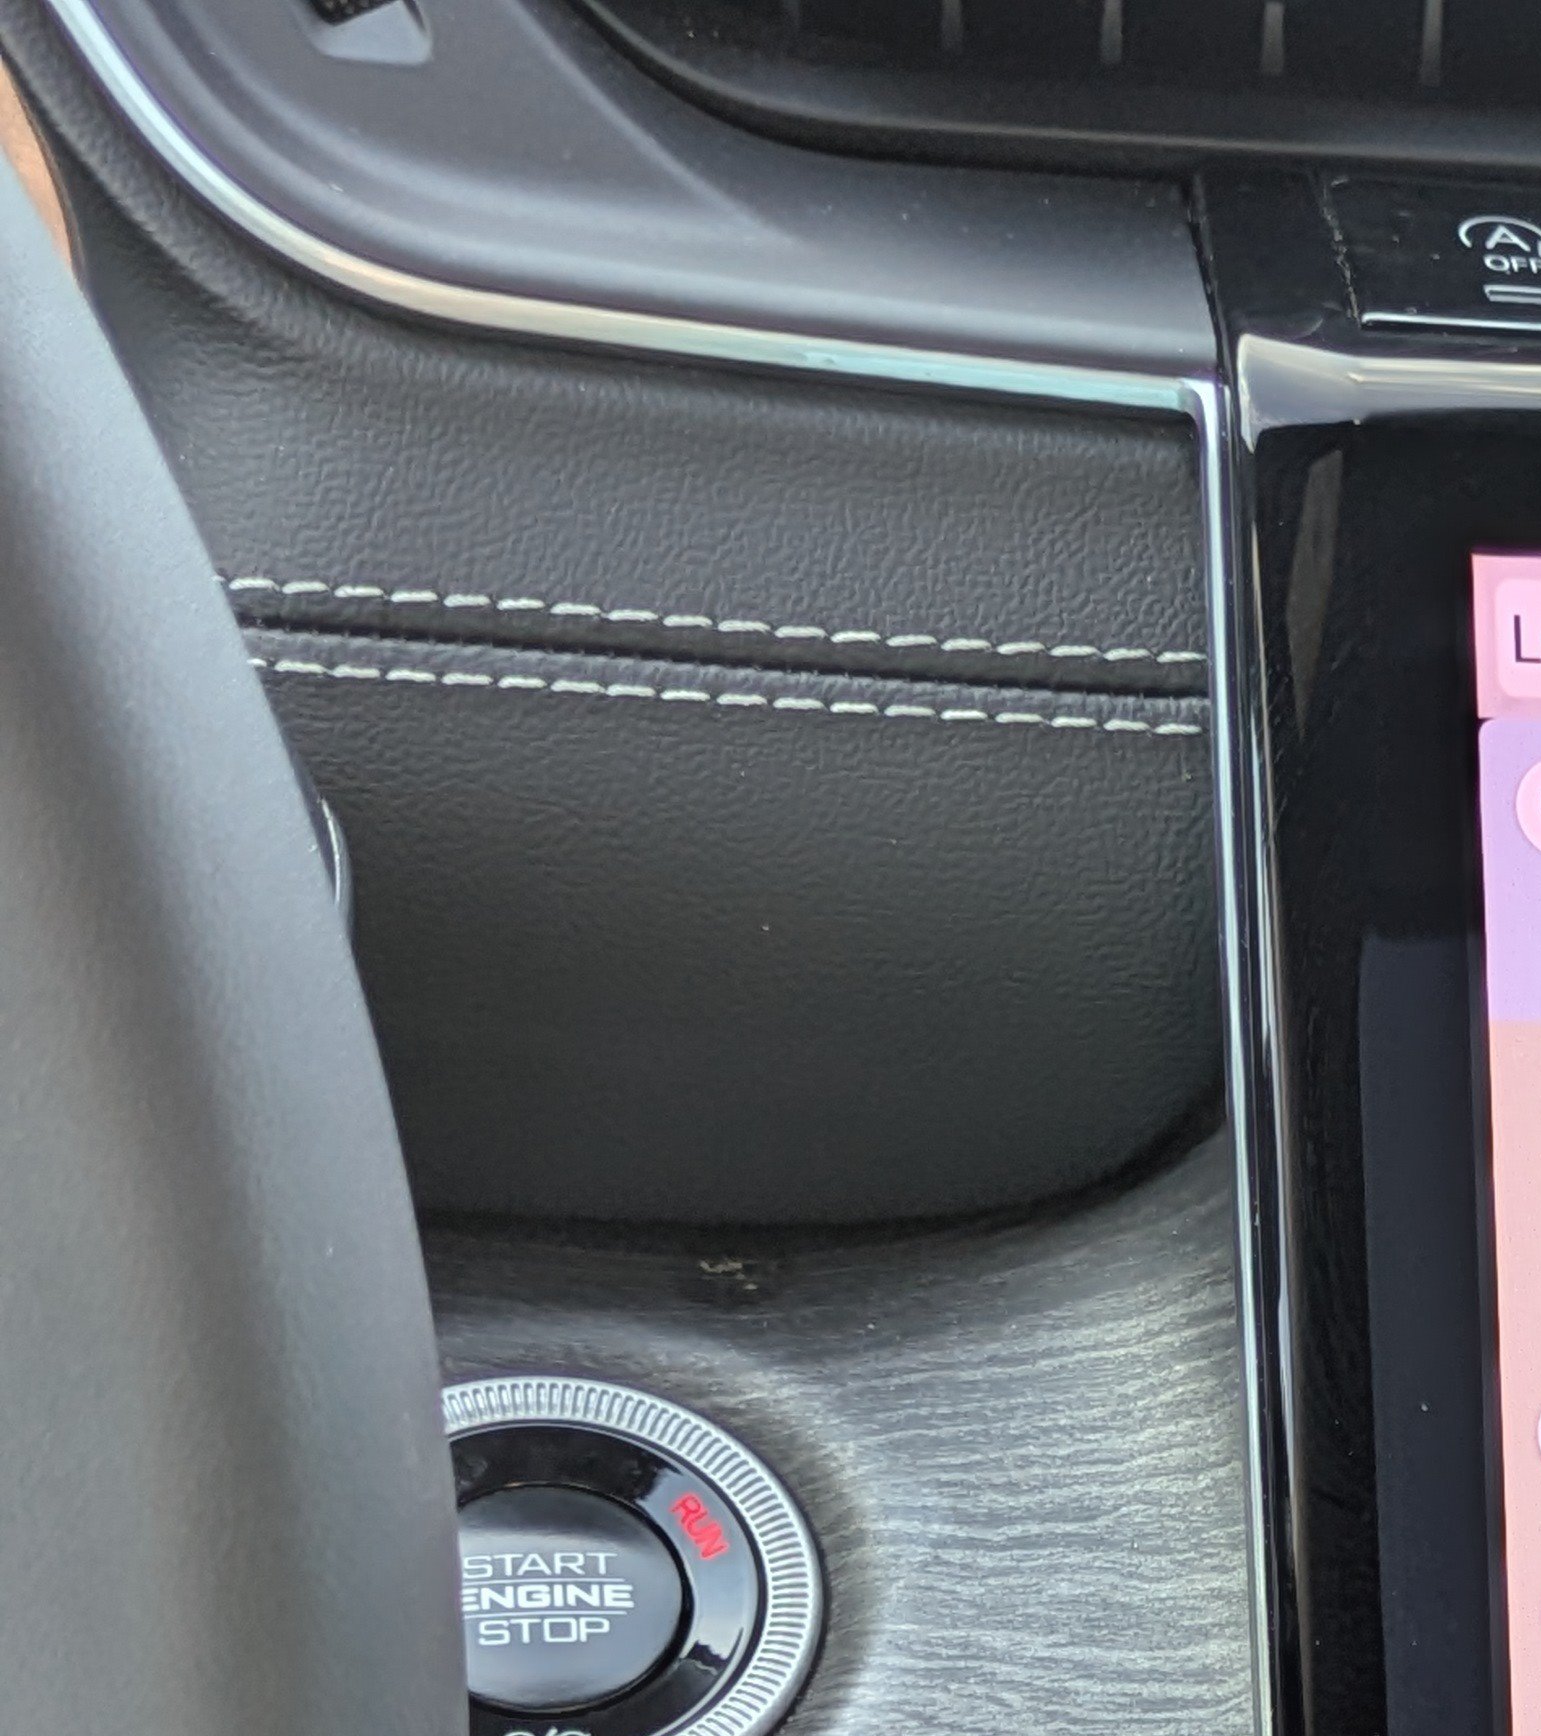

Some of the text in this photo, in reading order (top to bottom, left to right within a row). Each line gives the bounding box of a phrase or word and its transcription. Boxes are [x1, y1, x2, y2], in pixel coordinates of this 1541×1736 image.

[671, 1492, 728, 1560] RUN
[463, 1553, 617, 1577] START
[461, 1584, 634, 1611] ENGINE
[478, 1618, 611, 1646] STOP
